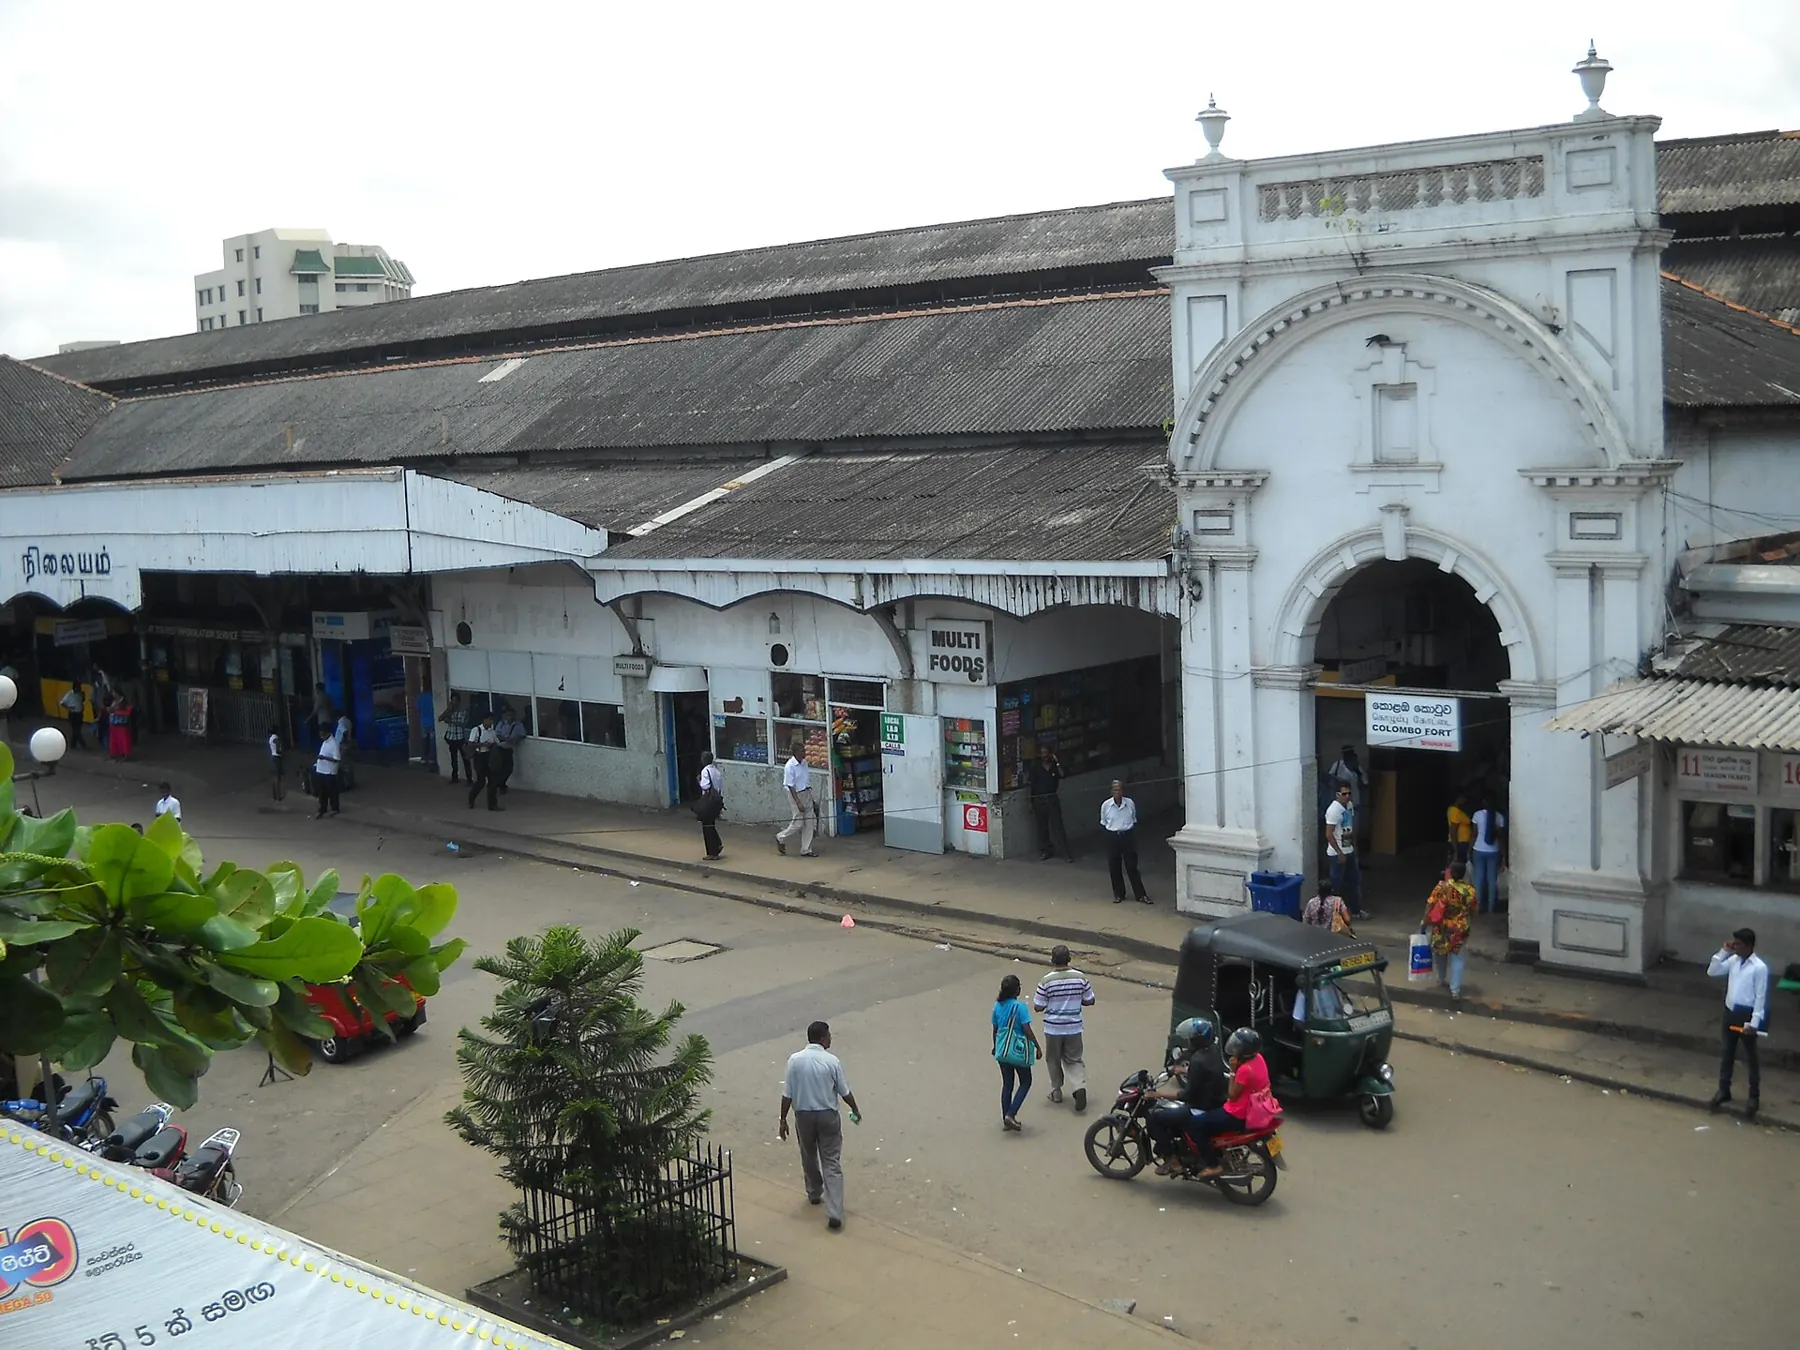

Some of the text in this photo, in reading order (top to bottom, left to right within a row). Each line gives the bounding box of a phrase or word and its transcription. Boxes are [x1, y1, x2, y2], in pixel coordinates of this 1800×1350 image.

[22, 545, 111, 583] நிலையம்
[931, 630, 980, 650] MULTI
[930, 654, 984, 673] FOODS
[1372, 701, 1451, 716] කොළඹ කොටුව
[1372, 724, 1452, 737] COLOMBO FORT
[1681, 754, 1700, 777] 11
[34, 1289, 53, 1304] 50
[134, 1324, 156, 1346] 5
[165, 1307, 193, 1337] ක්
